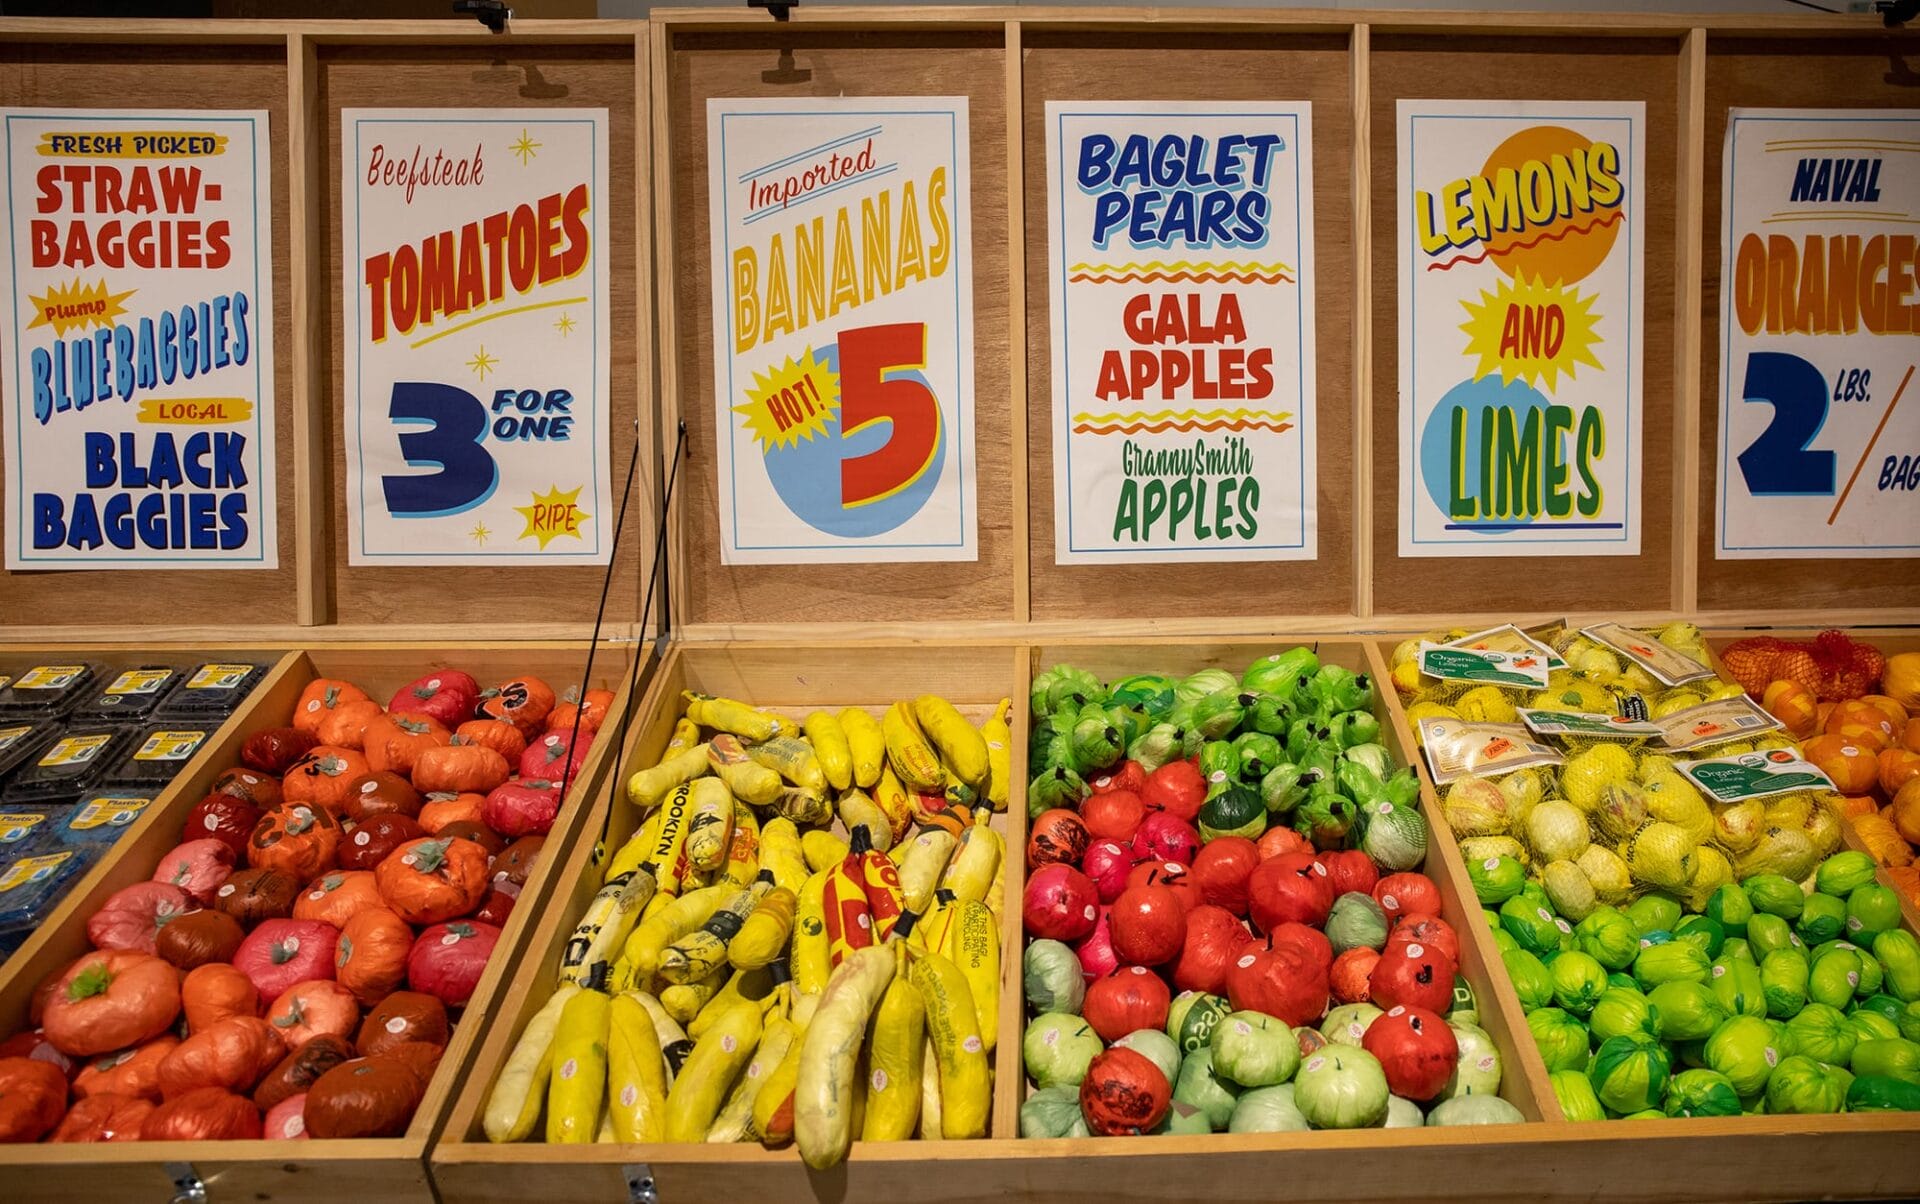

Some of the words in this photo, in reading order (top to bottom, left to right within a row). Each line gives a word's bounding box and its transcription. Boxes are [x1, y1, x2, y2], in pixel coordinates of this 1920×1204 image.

[51, 135, 123, 155] FRESH
[133, 135, 216, 155] PICKED
[367, 143, 485, 204] Beefsteak
[1077, 134, 1285, 196] BAGLET
[36, 165, 222, 214] STRAW-
[749, 138, 876, 211] Imported
[1416, 141, 1625, 256] LEMONS
[1790, 159, 1882, 203] NAVAL
[30, 220, 231, 269] BAGGIES
[1092, 190, 1270, 251] PEARS
[365, 184, 590, 344] TOMATOES
[732, 166, 951, 355] BANANAS
[44, 299, 107, 322] plump
[1123, 293, 1247, 345] GALA
[1499, 303, 1565, 360] AND
[31, 291, 249, 425] BLUEBAGGIES
[1095, 348, 1274, 402] APPLES
[1834, 368, 1872, 402] LBS.
[159, 403, 228, 420] LOCAL
[491, 389, 574, 416] FOR
[492, 416, 575, 442] ONE
[766, 373, 825, 432] HOT!
[837, 322, 941, 510] 5
[1737, 351, 1837, 497] 2
[85, 432, 248, 490] BLACK
[381, 382, 500, 518] 3
[1450, 405, 1606, 521] LIMES
[33, 493, 249, 551] BAGGIES
[532, 503, 578, 533] RIPE
[1113, 476, 1260, 542] APPLES
[1697, 767, 1745, 778] Organic
